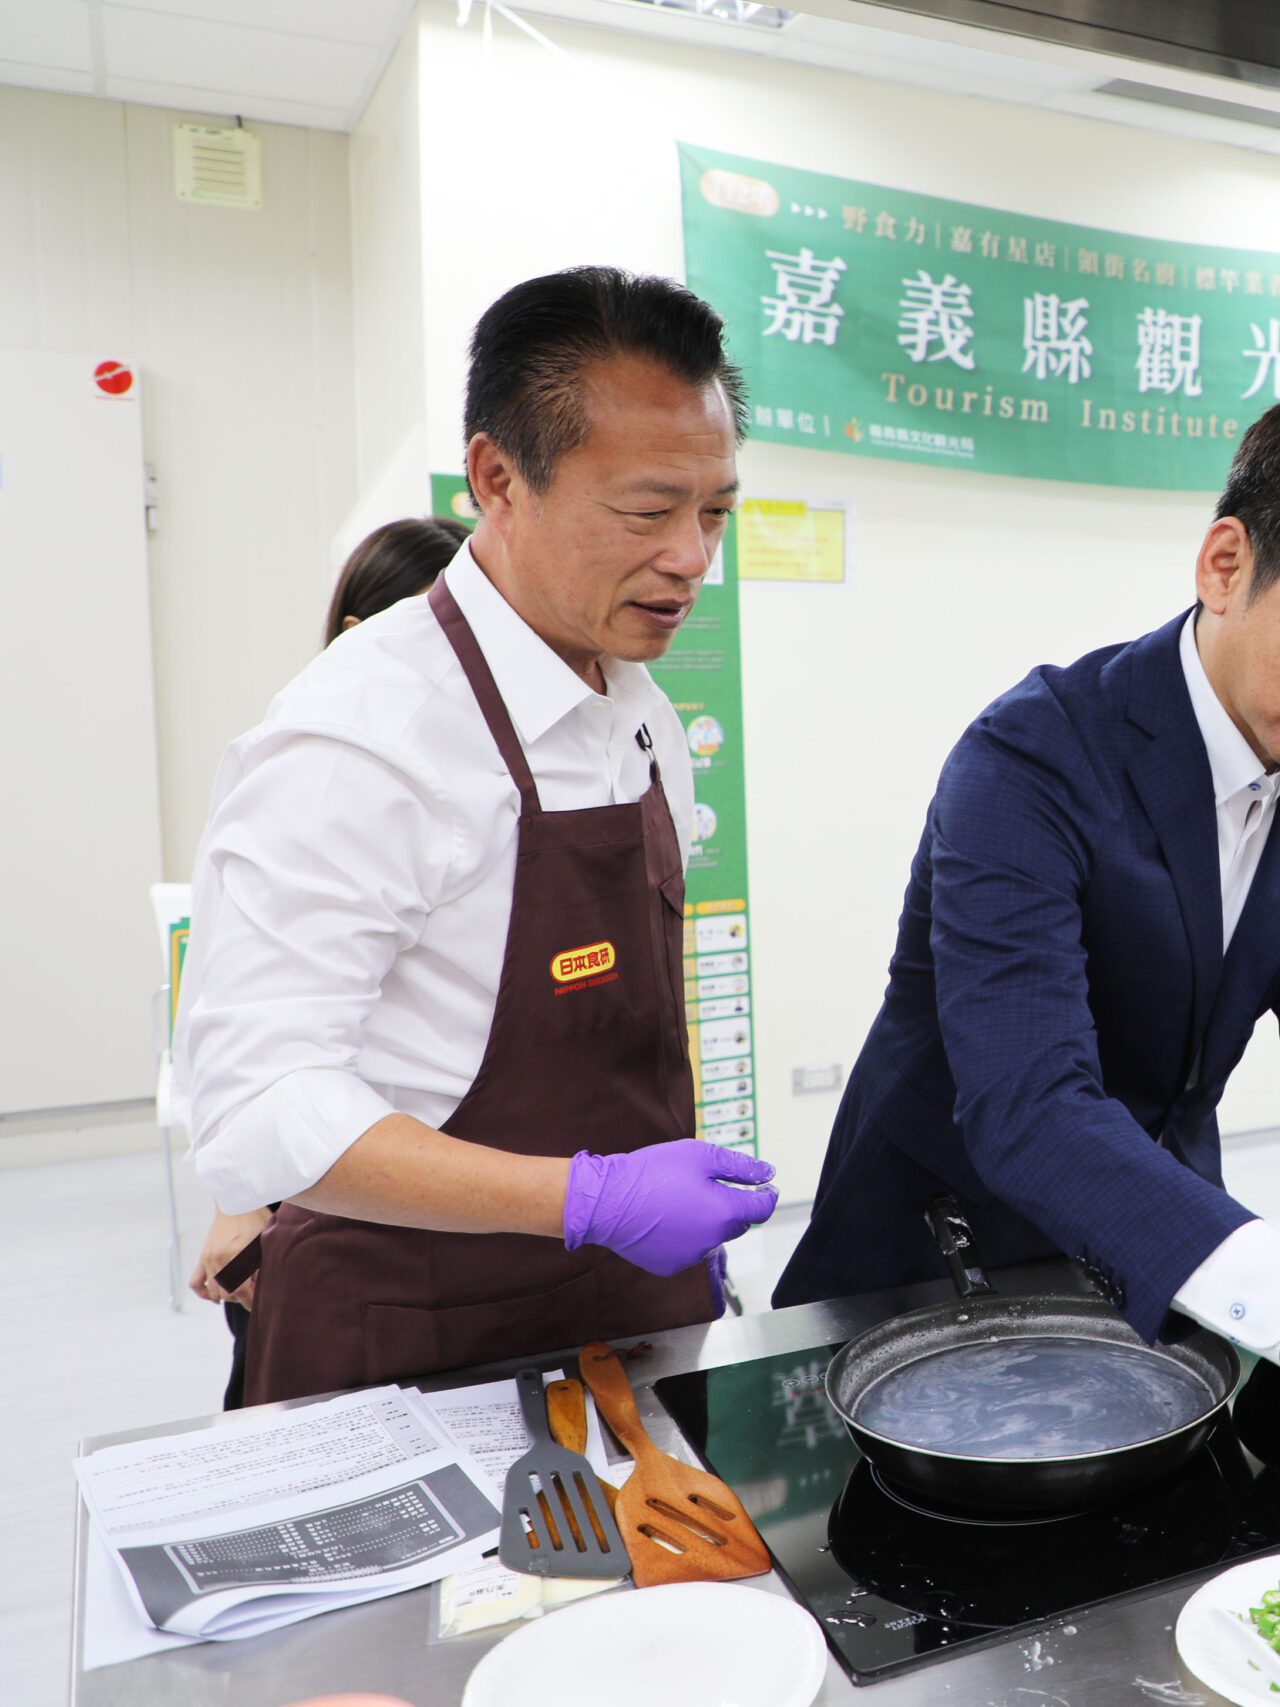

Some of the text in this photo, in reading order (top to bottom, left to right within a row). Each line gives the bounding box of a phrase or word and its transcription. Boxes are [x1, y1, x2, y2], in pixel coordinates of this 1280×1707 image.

[841, 204, 926, 246] 野食力
[881, 371, 1239, 440] Tourism Institute
[559, 947, 610, 976] 日本食研
